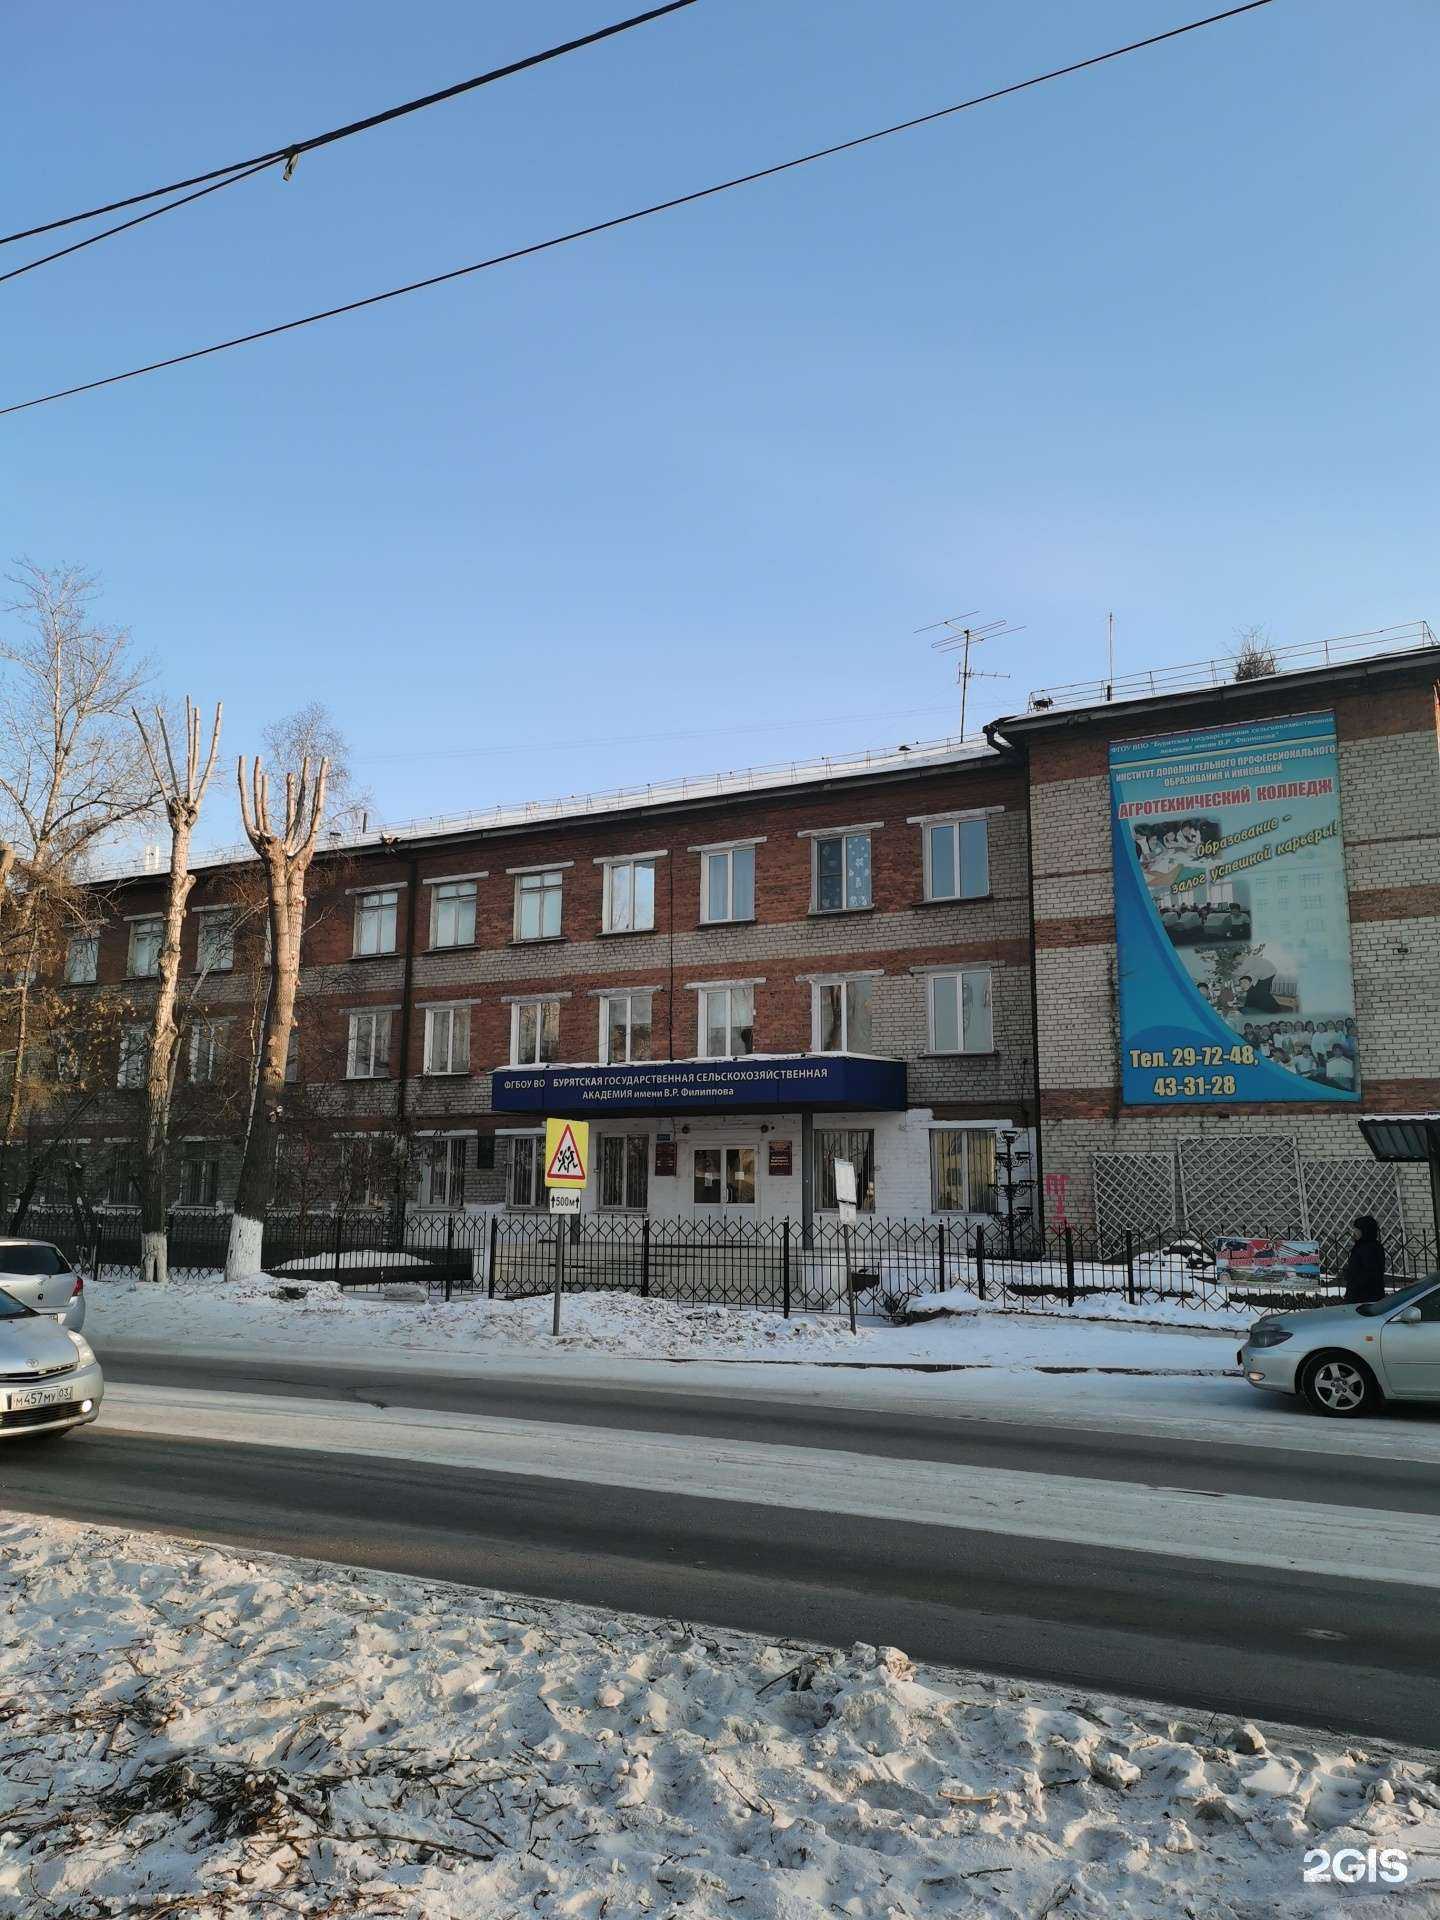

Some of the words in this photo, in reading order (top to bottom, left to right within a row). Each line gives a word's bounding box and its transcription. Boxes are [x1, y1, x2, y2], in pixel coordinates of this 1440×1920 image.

[1116, 769, 1154, 782] ИНСТИТУТ
[1156, 758, 1236, 777] ДОПОЛНИТЕЛЬНОГО
[1238, 744, 1336, 765] ПРОФЕССИОНАЛЬНОГО
[1164, 771, 1222, 787] ОБРАЗОВАНИЯ
[1119, 785, 1251, 819] АГРОТЕХНИЧЕСКИЙ
[1256, 778, 1333, 801] КОЛЛЕДЖ
[1197, 817, 1279, 857] Образование
[1172, 874, 1207, 894] залог
[1210, 845, 1272, 882] успешной
[1276, 820, 1338, 856] карьеры!
[1129, 1049, 1169, 1068] Тел.
[1172, 1045, 1259, 1067] 29-72-48,
[504, 1080, 533, 1089] ФГБОУ
[533, 1079, 545, 1088] ВО
[553, 1077, 602, 1088] БУРЯТСКАЯ
[604, 1073, 694, 1086] ГОСУДАРСТВЕННАЯ
[696, 1068, 828, 1082] СЕЛЬСКОХОЗЯЙСТВЕННАЯ
[1153, 1075, 1236, 1096] 43-31-28
[582, 1089, 632, 1100] АКАДЕМИЯ
[634, 1090, 663, 1099] имени
[664, 1088, 679, 1097] В.Р.
[681, 1087, 734, 1097] Филиппова
[555, 1196, 575, 1207] 500м
